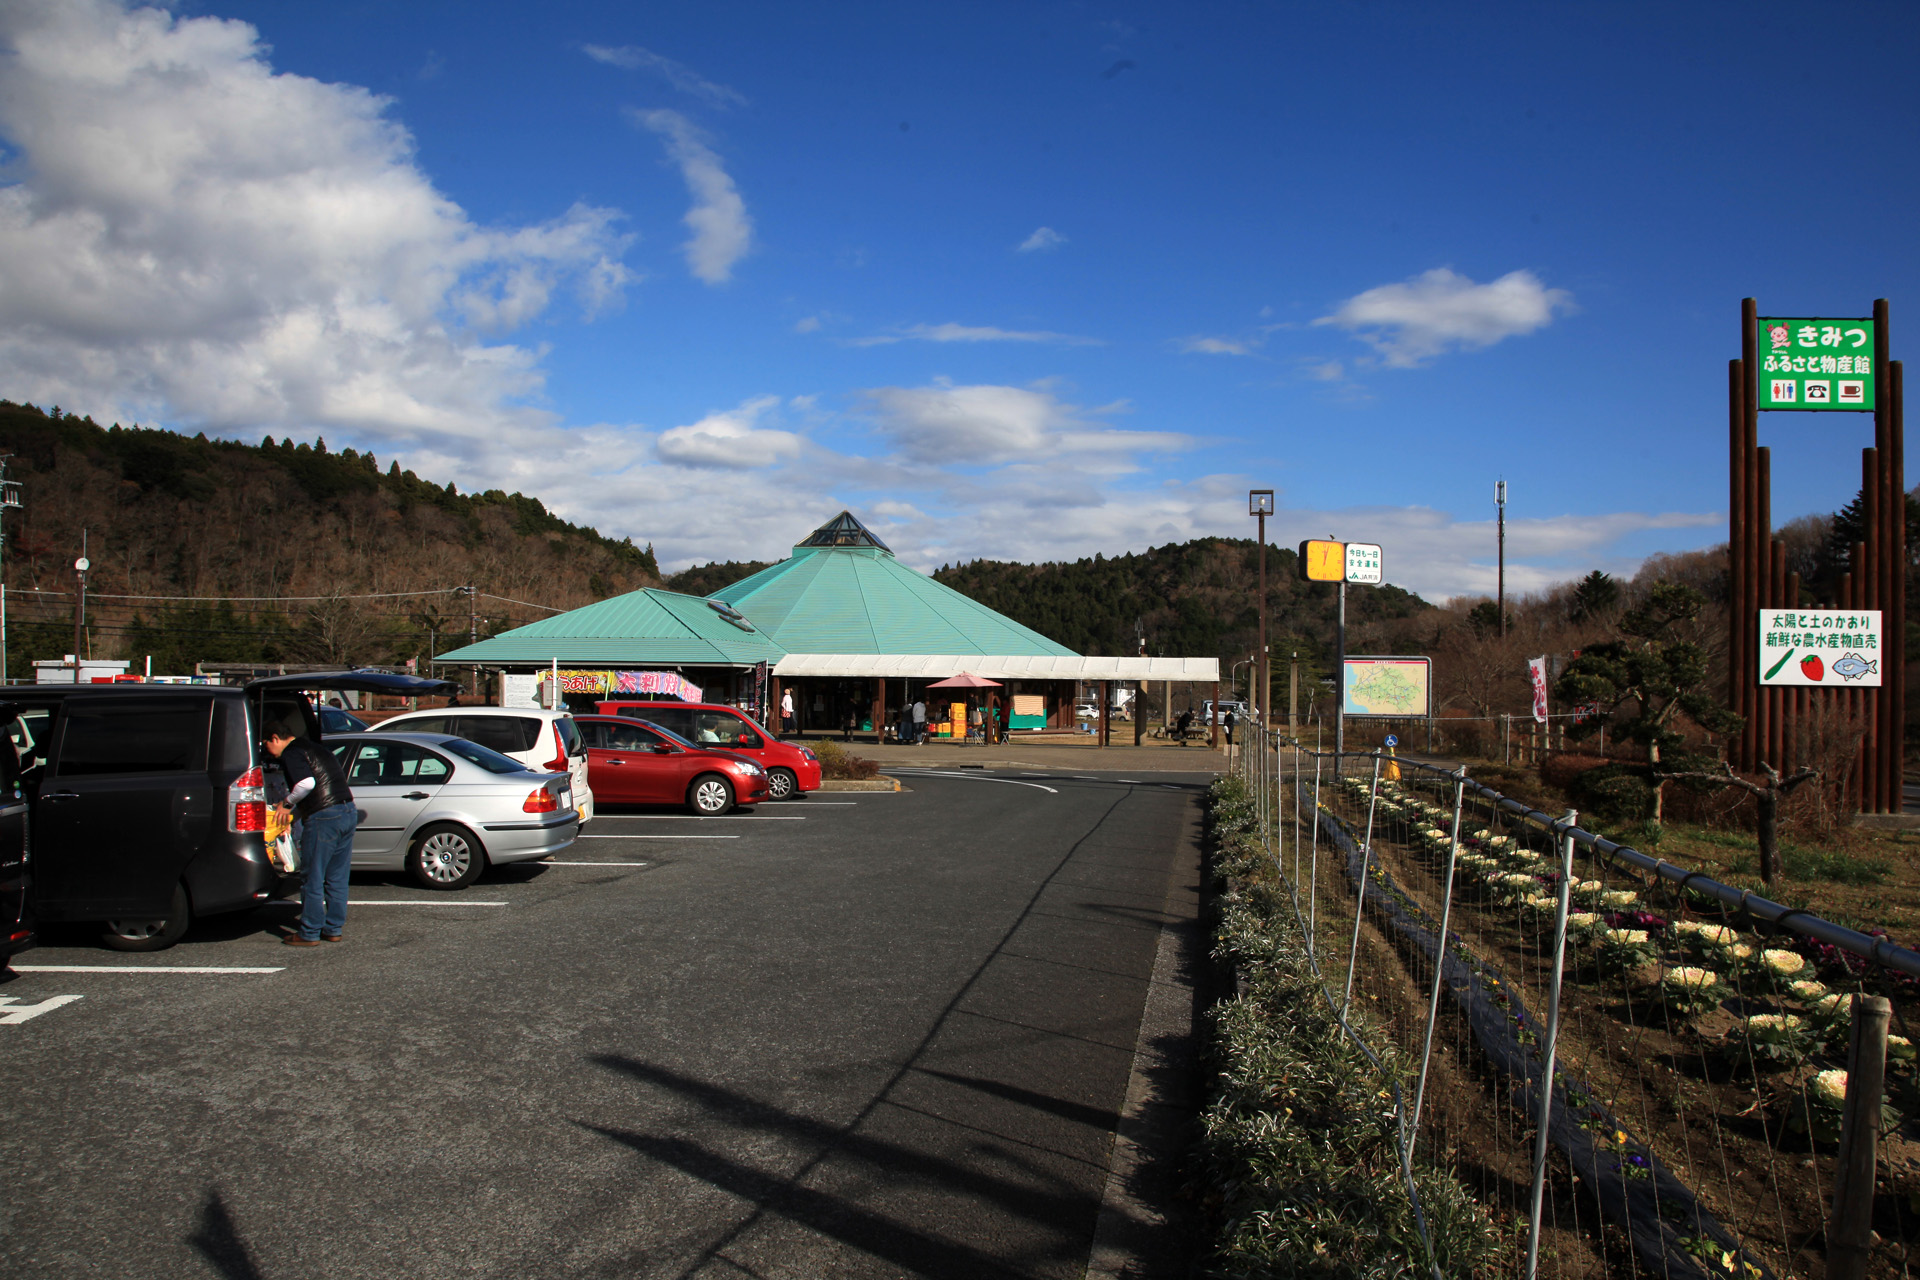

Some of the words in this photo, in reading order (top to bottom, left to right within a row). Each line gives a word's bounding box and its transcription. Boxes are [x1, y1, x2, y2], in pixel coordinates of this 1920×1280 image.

[1797, 325, 1867, 348] きみつ
[1763, 355, 1871, 375] ふるさと物産館
[1349, 548, 1378, 559] 今日も一日
[1349, 559, 1379, 568] 安全運転
[1772, 613, 1870, 629] 太陽と土のかおり
[1765, 632, 1877, 649] 新鮮な農水産物直売
